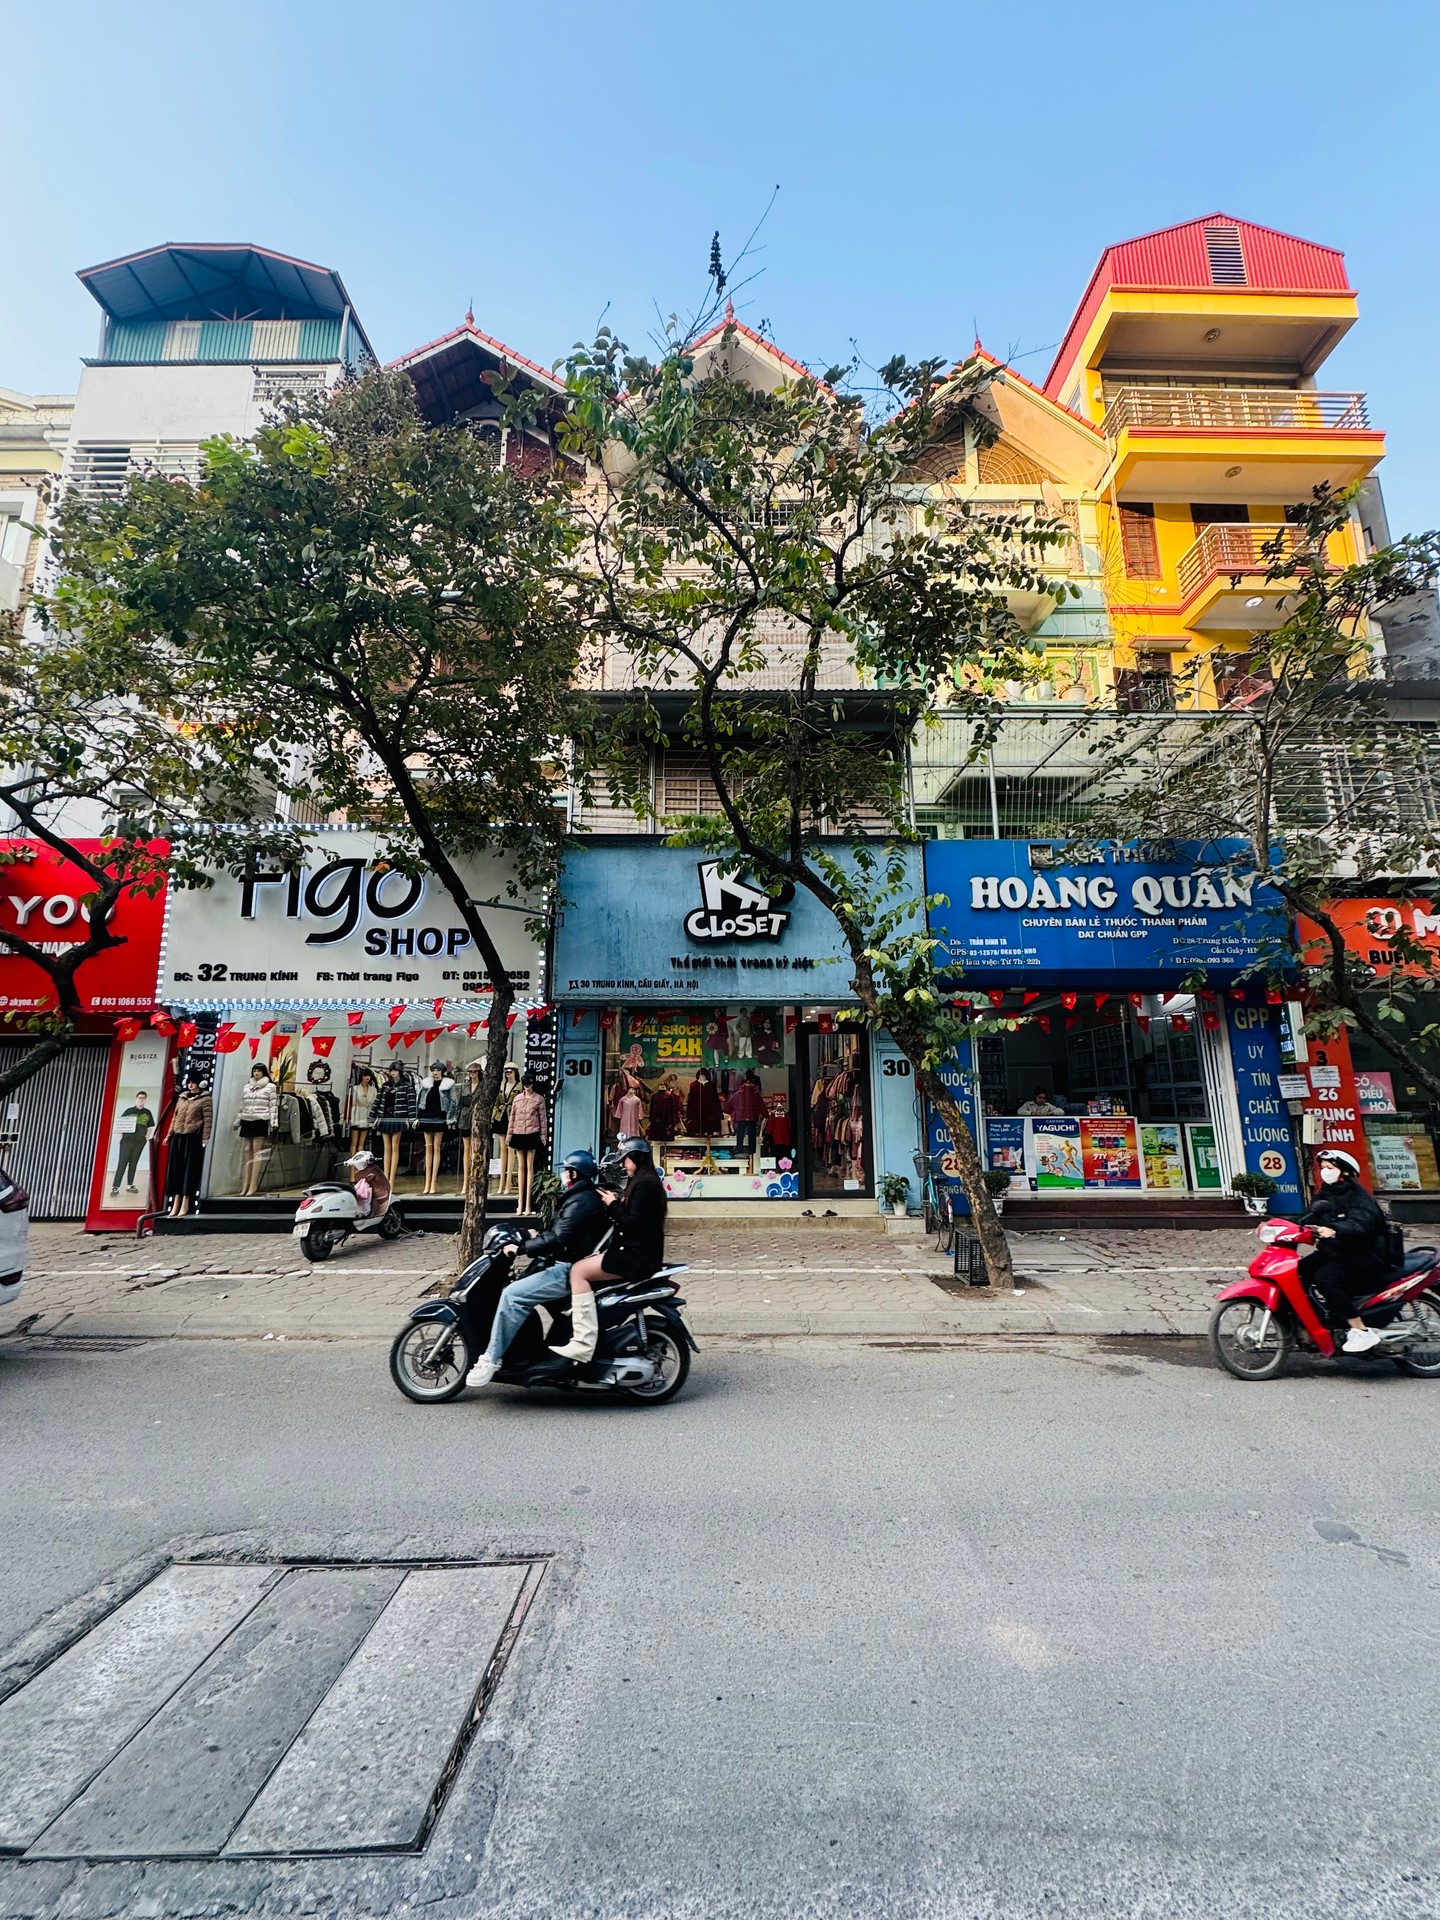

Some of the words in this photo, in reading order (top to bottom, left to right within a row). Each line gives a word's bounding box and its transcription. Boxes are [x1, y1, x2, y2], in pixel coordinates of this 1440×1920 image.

[969, 869, 1118, 909] HOÀNG
[687, 911, 787, 938] CLOSET
[1022, 918, 1062, 927] CHUYÊN
[1065, 917, 1086, 927] BÁN
[1103, 914, 1138, 926] THUỐC
[1130, 930, 1149, 938] GPP
[365, 927, 472, 958] SHOP
[740, 956, 774, 969] trang
[197, 963, 228, 982] 32
[229, 971, 267, 982] TRUNG
[270, 969, 298, 981] KÍNH
[316, 971, 334, 981] FB:
[363, 972, 392, 982] trang
[580, 980, 590, 989] 30
[592, 980, 615, 989] TRUNG
[674, 978, 684, 989] HÀ
[687, 979, 699, 990] NỘI
[101, 997, 116, 1006] 093
[117, 997, 136, 1006] 1066
[136, 997, 152, 1006] 555
[1233, 1007, 1270, 1030] GPP
[193, 1033, 215, 1048] 32
[528, 1033, 552, 1047] 32
[657, 1038, 703, 1057] 54K
[1247, 1045, 1264, 1059] UY
[565, 1059, 593, 1077] 30
[882, 1059, 911, 1077] 30
[1250, 1068, 1272, 1087] TÍN
[1318, 1087, 1339, 1101] 26
[1248, 1094, 1280, 1115] CHẤT
[1369, 1098, 1396, 1112] HOÀ
[1037, 1124, 1077, 1132] YAGUCHI
[1323, 1125, 1355, 1142] ÍNH
[1247, 1126, 1290, 1147] LƯỢNG
[1262, 1156, 1282, 1170] 28
